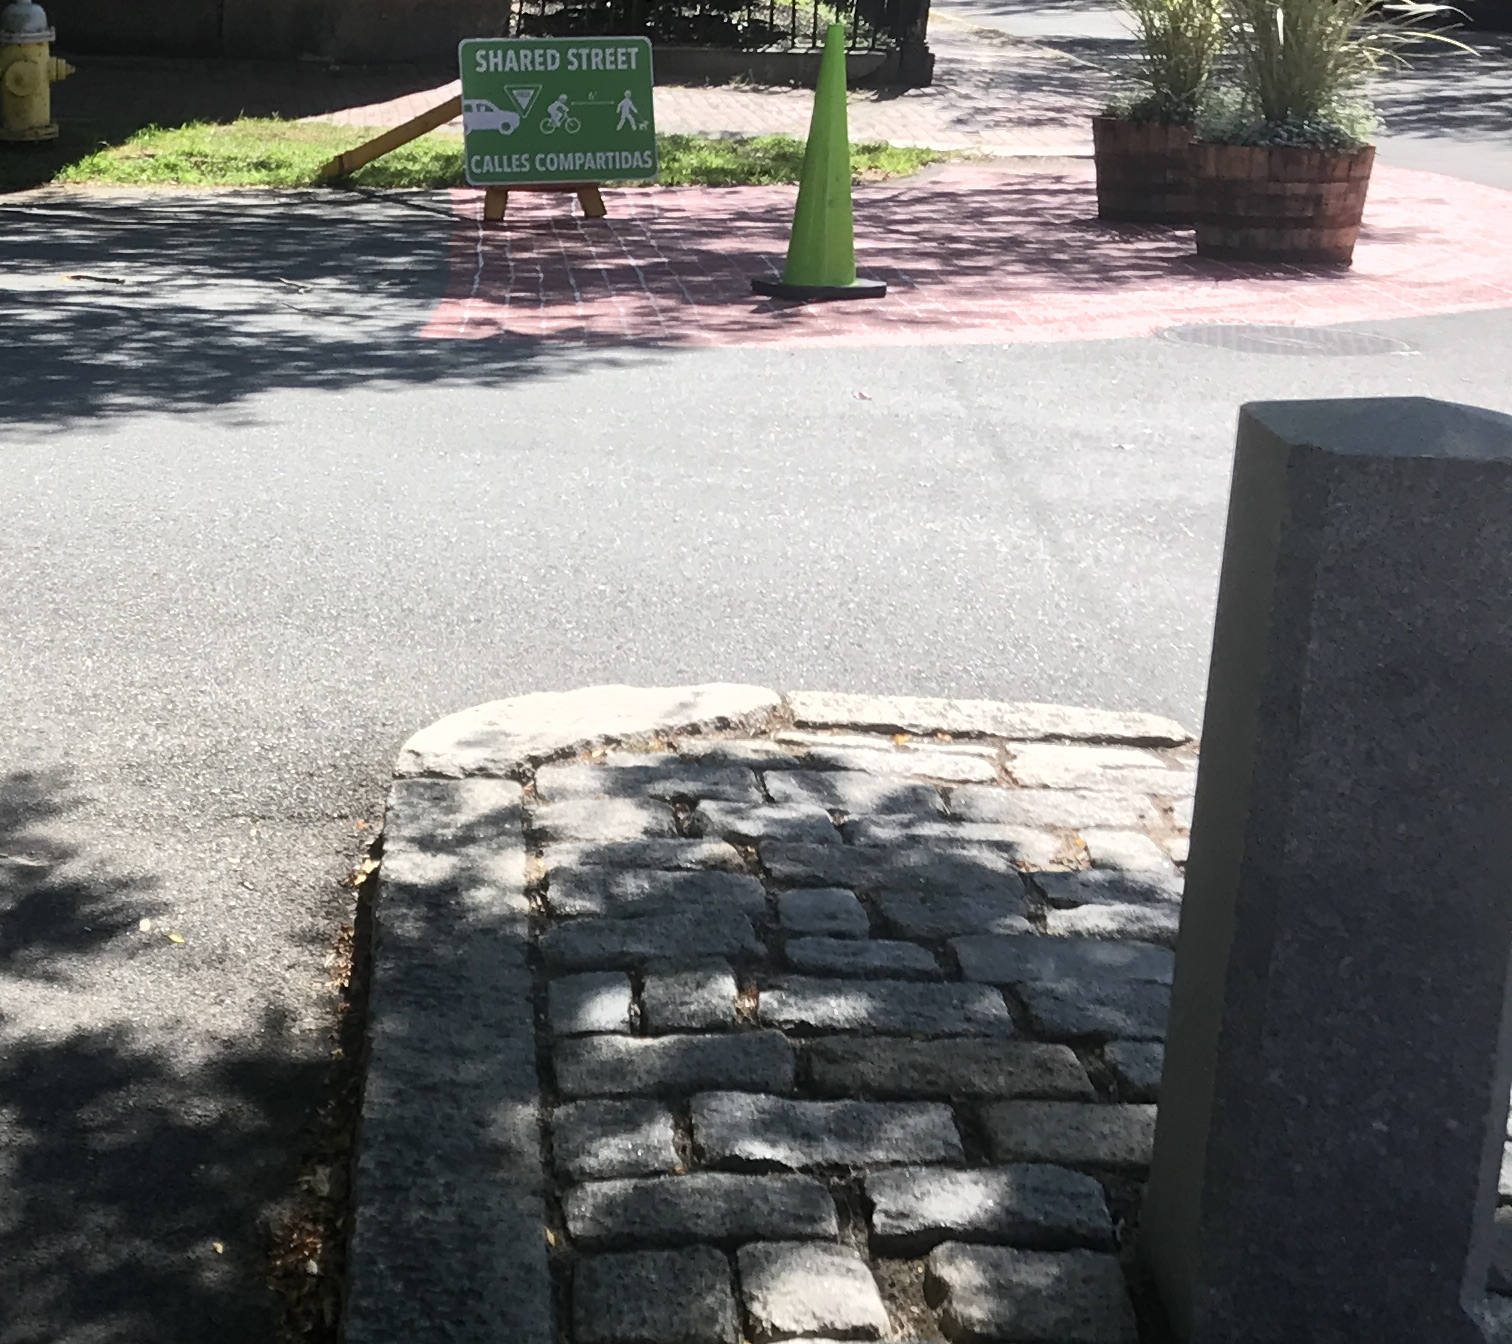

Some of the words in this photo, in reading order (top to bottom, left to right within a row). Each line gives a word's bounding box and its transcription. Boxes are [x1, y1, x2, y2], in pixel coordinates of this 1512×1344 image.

[475, 49, 560, 72] SHARED
[567, 47, 639, 71] STREET
[471, 154, 530, 173] CALLES
[535, 151, 653, 171] COMPARTIDAS
